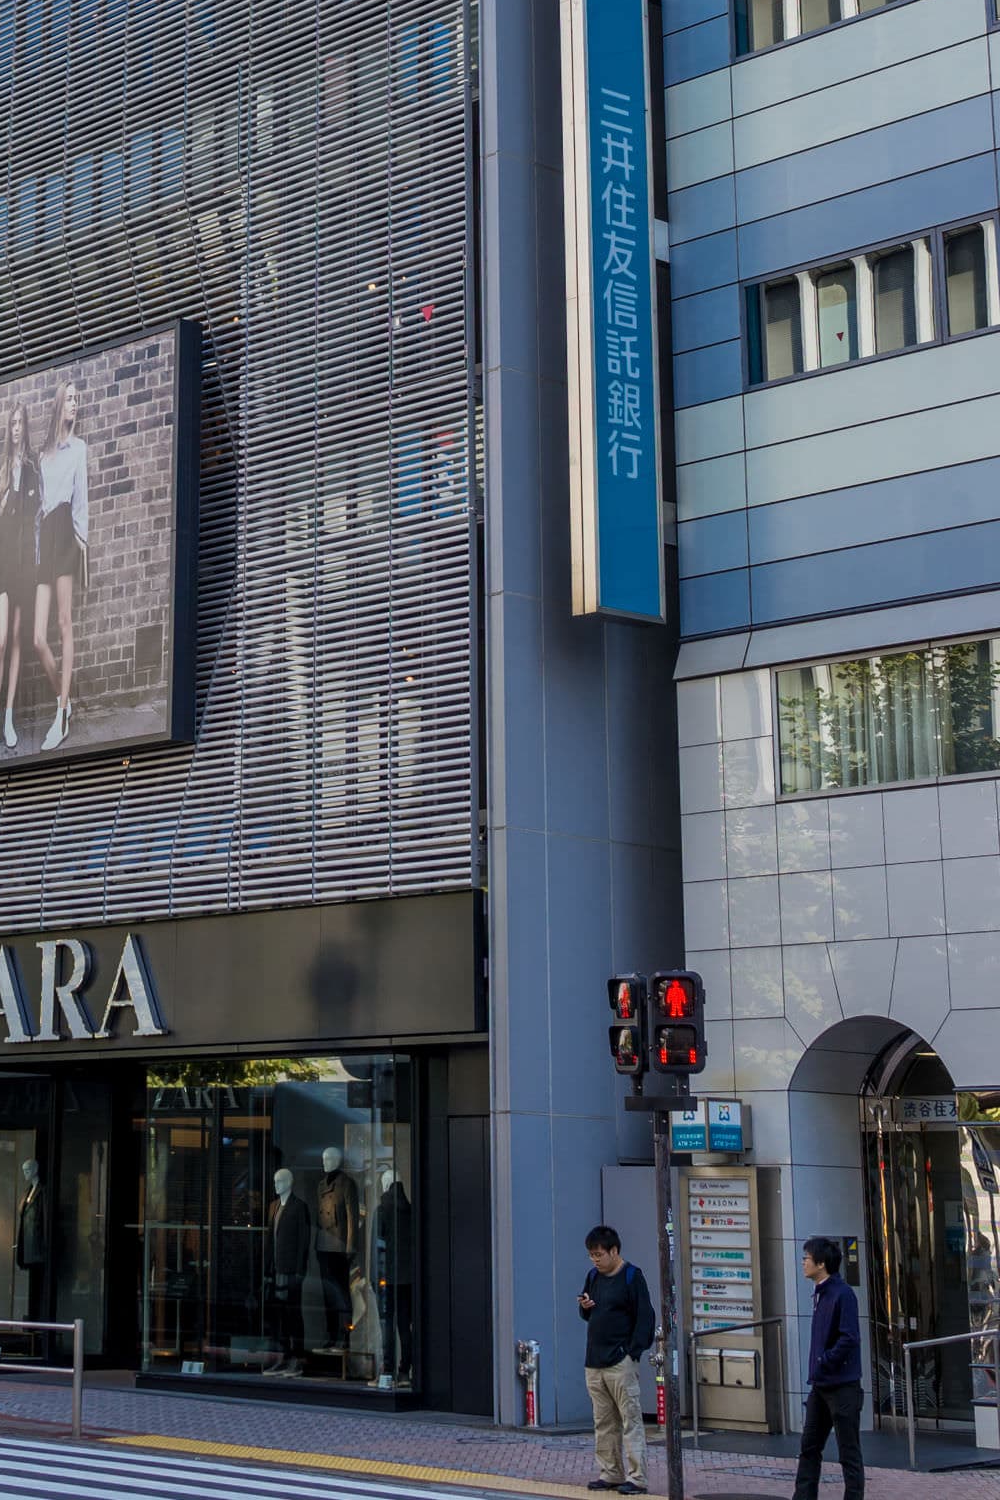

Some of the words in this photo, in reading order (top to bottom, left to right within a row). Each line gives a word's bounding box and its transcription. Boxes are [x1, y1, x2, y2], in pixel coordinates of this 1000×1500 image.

[600, 87, 643, 481] 三井住友信託銀行
[708, 1199, 738, 1207] PASONA
